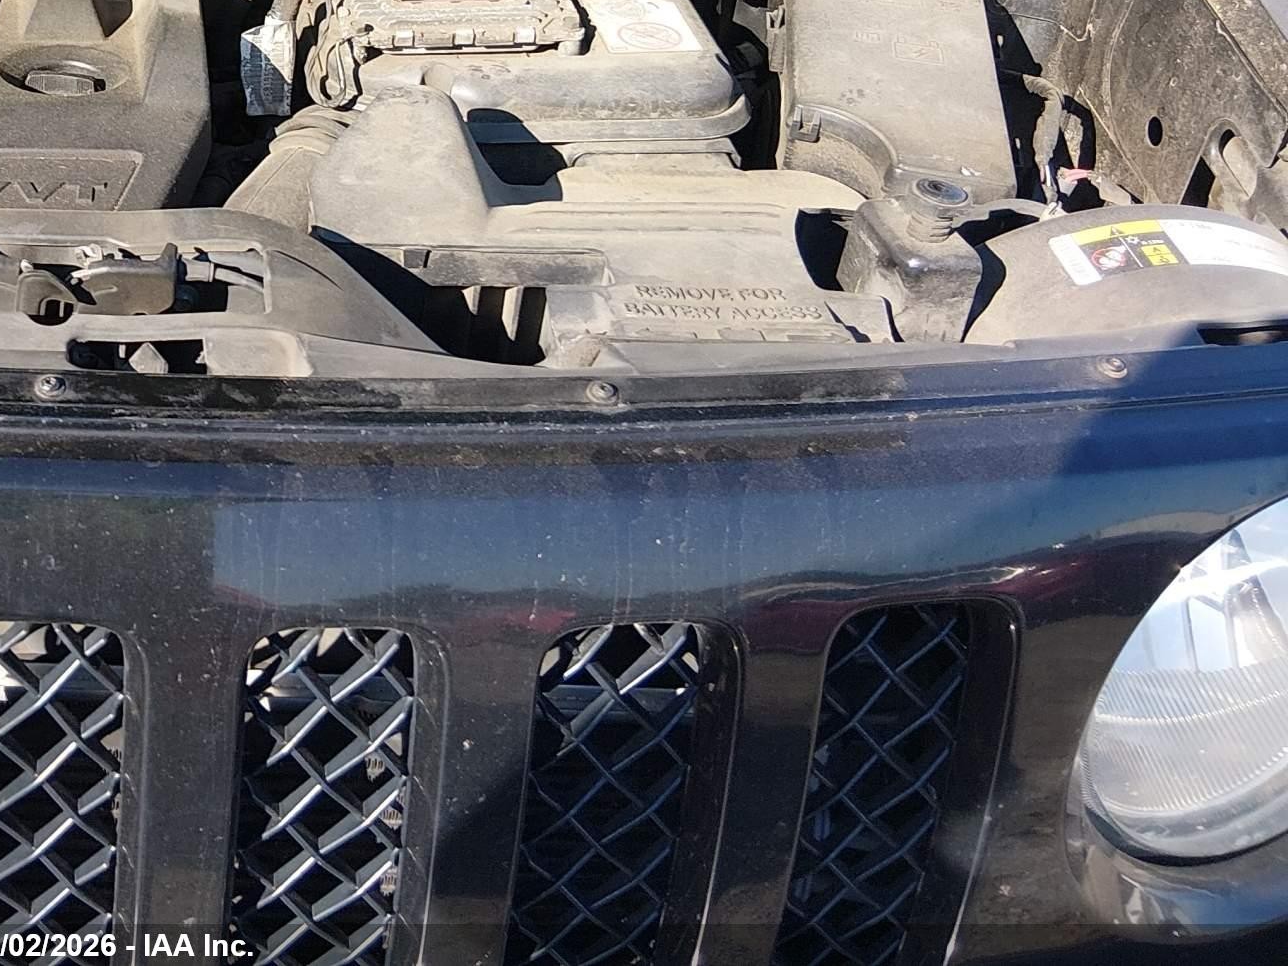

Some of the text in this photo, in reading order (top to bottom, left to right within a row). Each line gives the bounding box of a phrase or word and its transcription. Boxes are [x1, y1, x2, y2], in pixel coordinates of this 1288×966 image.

[635, 285, 787, 301] REMOVE FOR
[623, 302, 823, 321] BATTERY ACCESS
